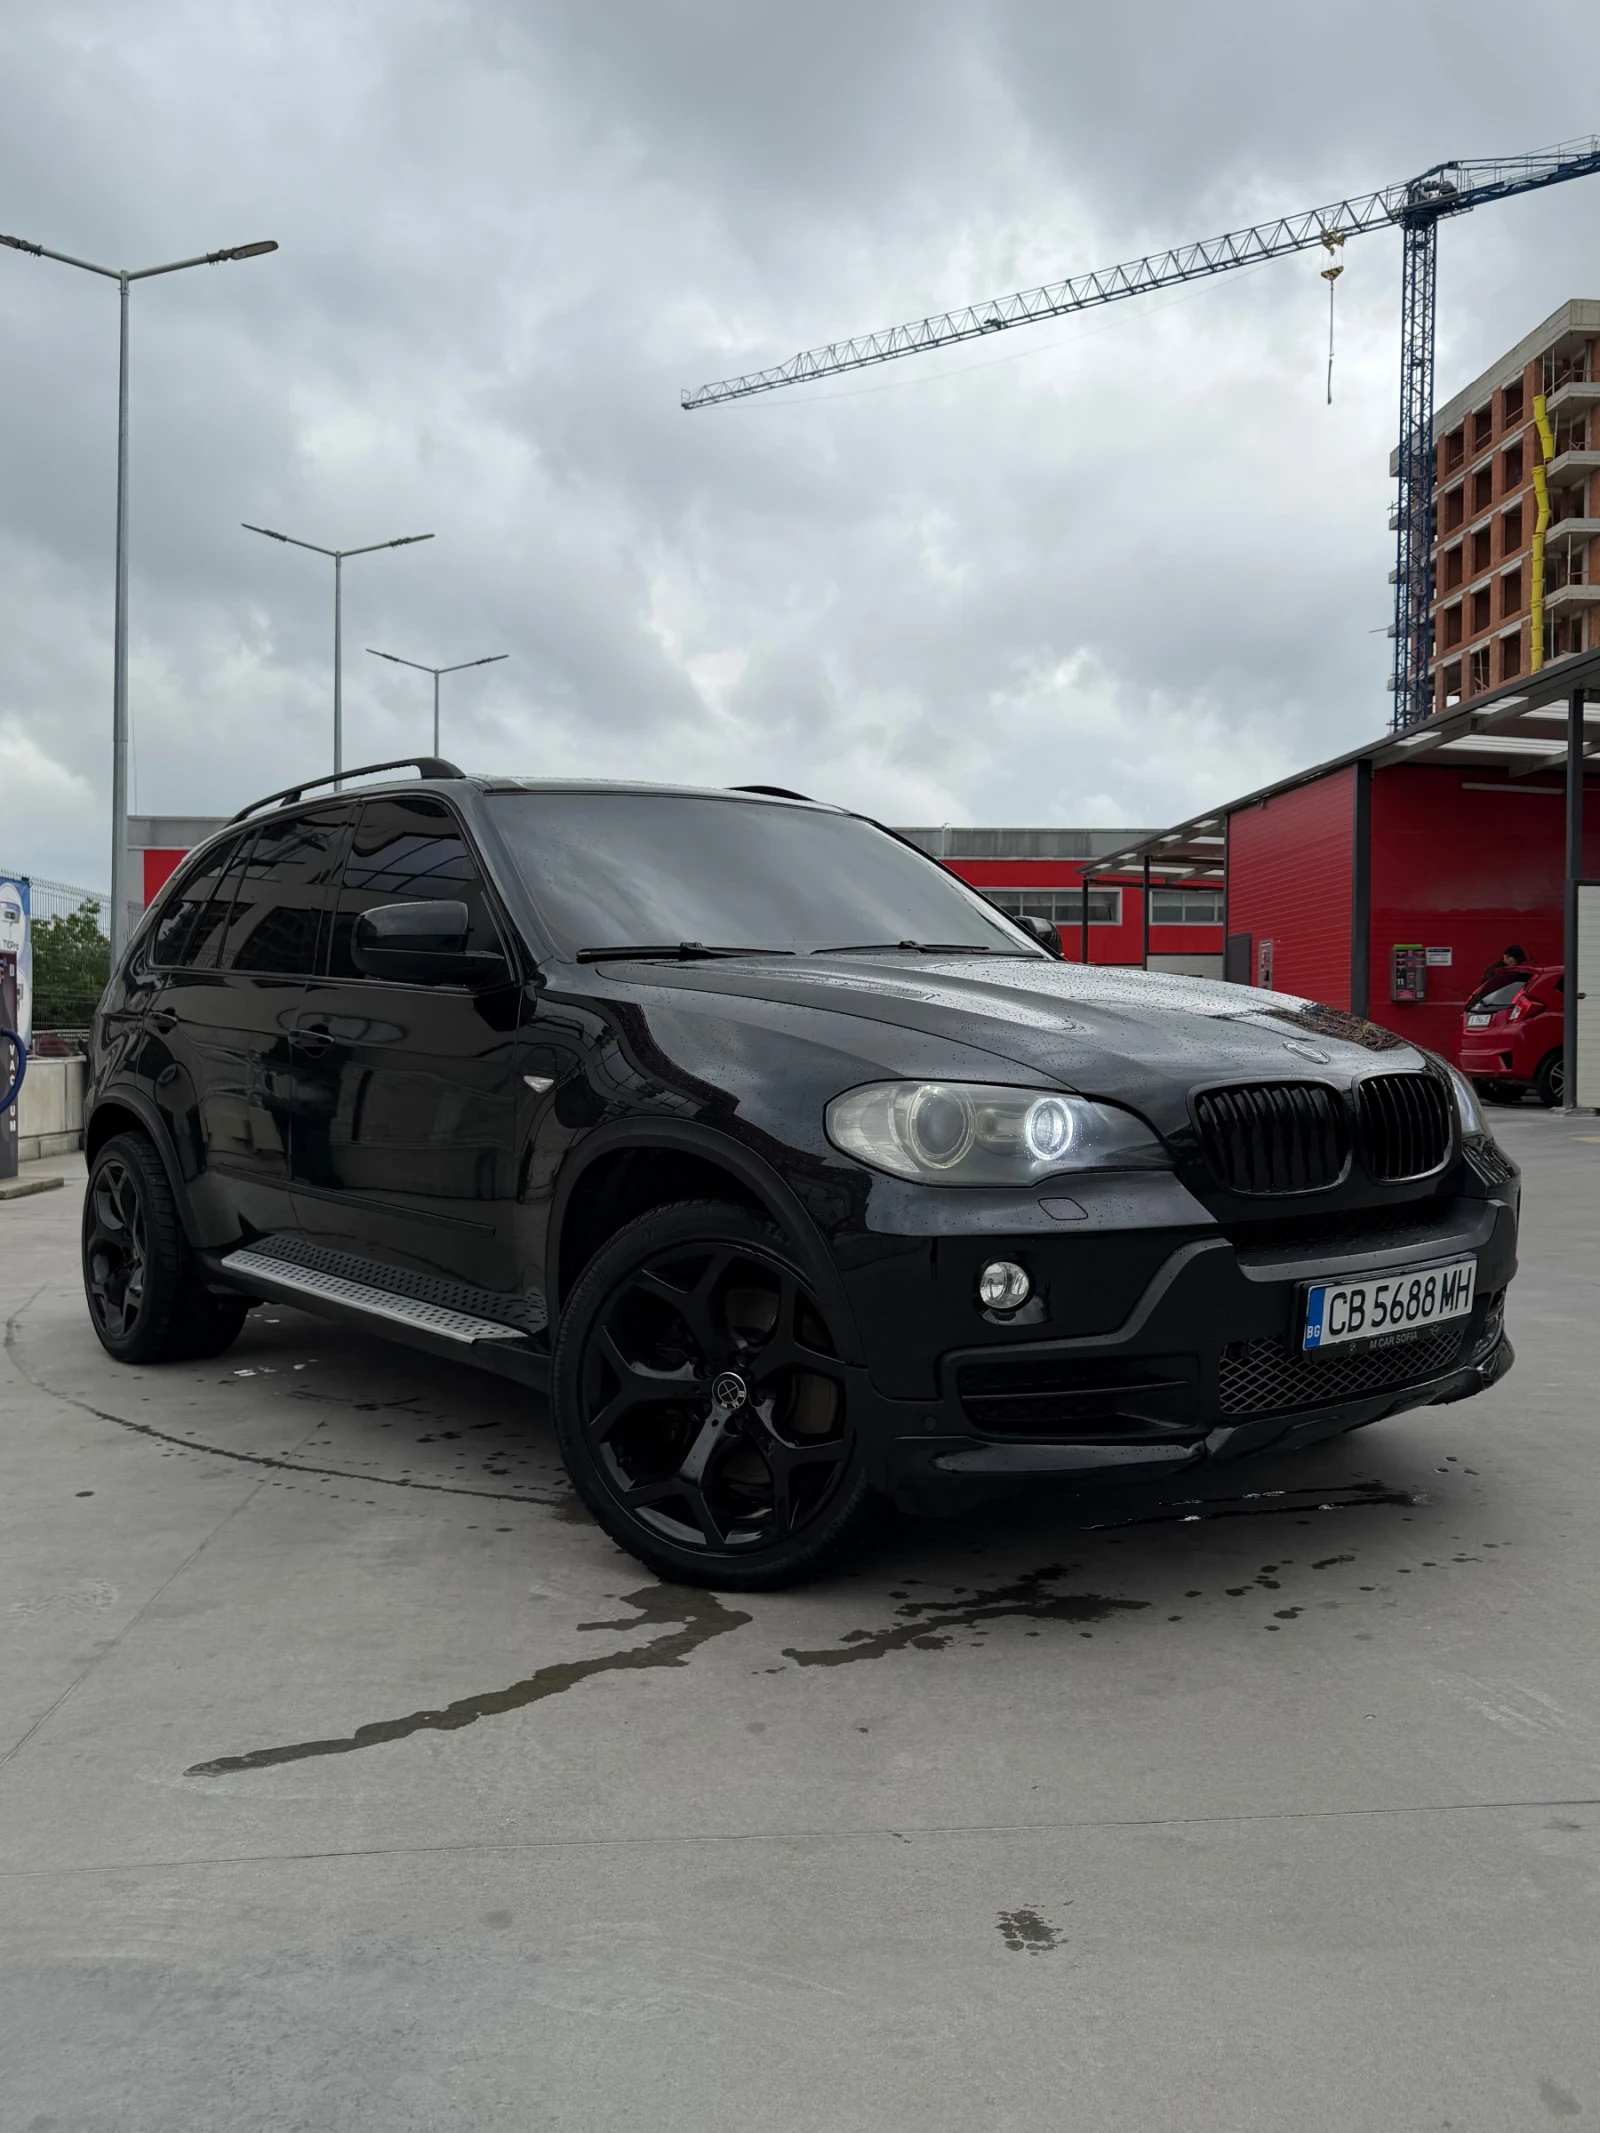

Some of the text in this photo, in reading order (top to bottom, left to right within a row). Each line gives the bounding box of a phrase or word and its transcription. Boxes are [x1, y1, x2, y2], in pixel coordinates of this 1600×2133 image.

[1328, 1266, 1473, 1336] CB 5688 MH
[1306, 1324, 1321, 1338] BG
[1369, 1331, 1418, 1350] M CAR SOFIA
